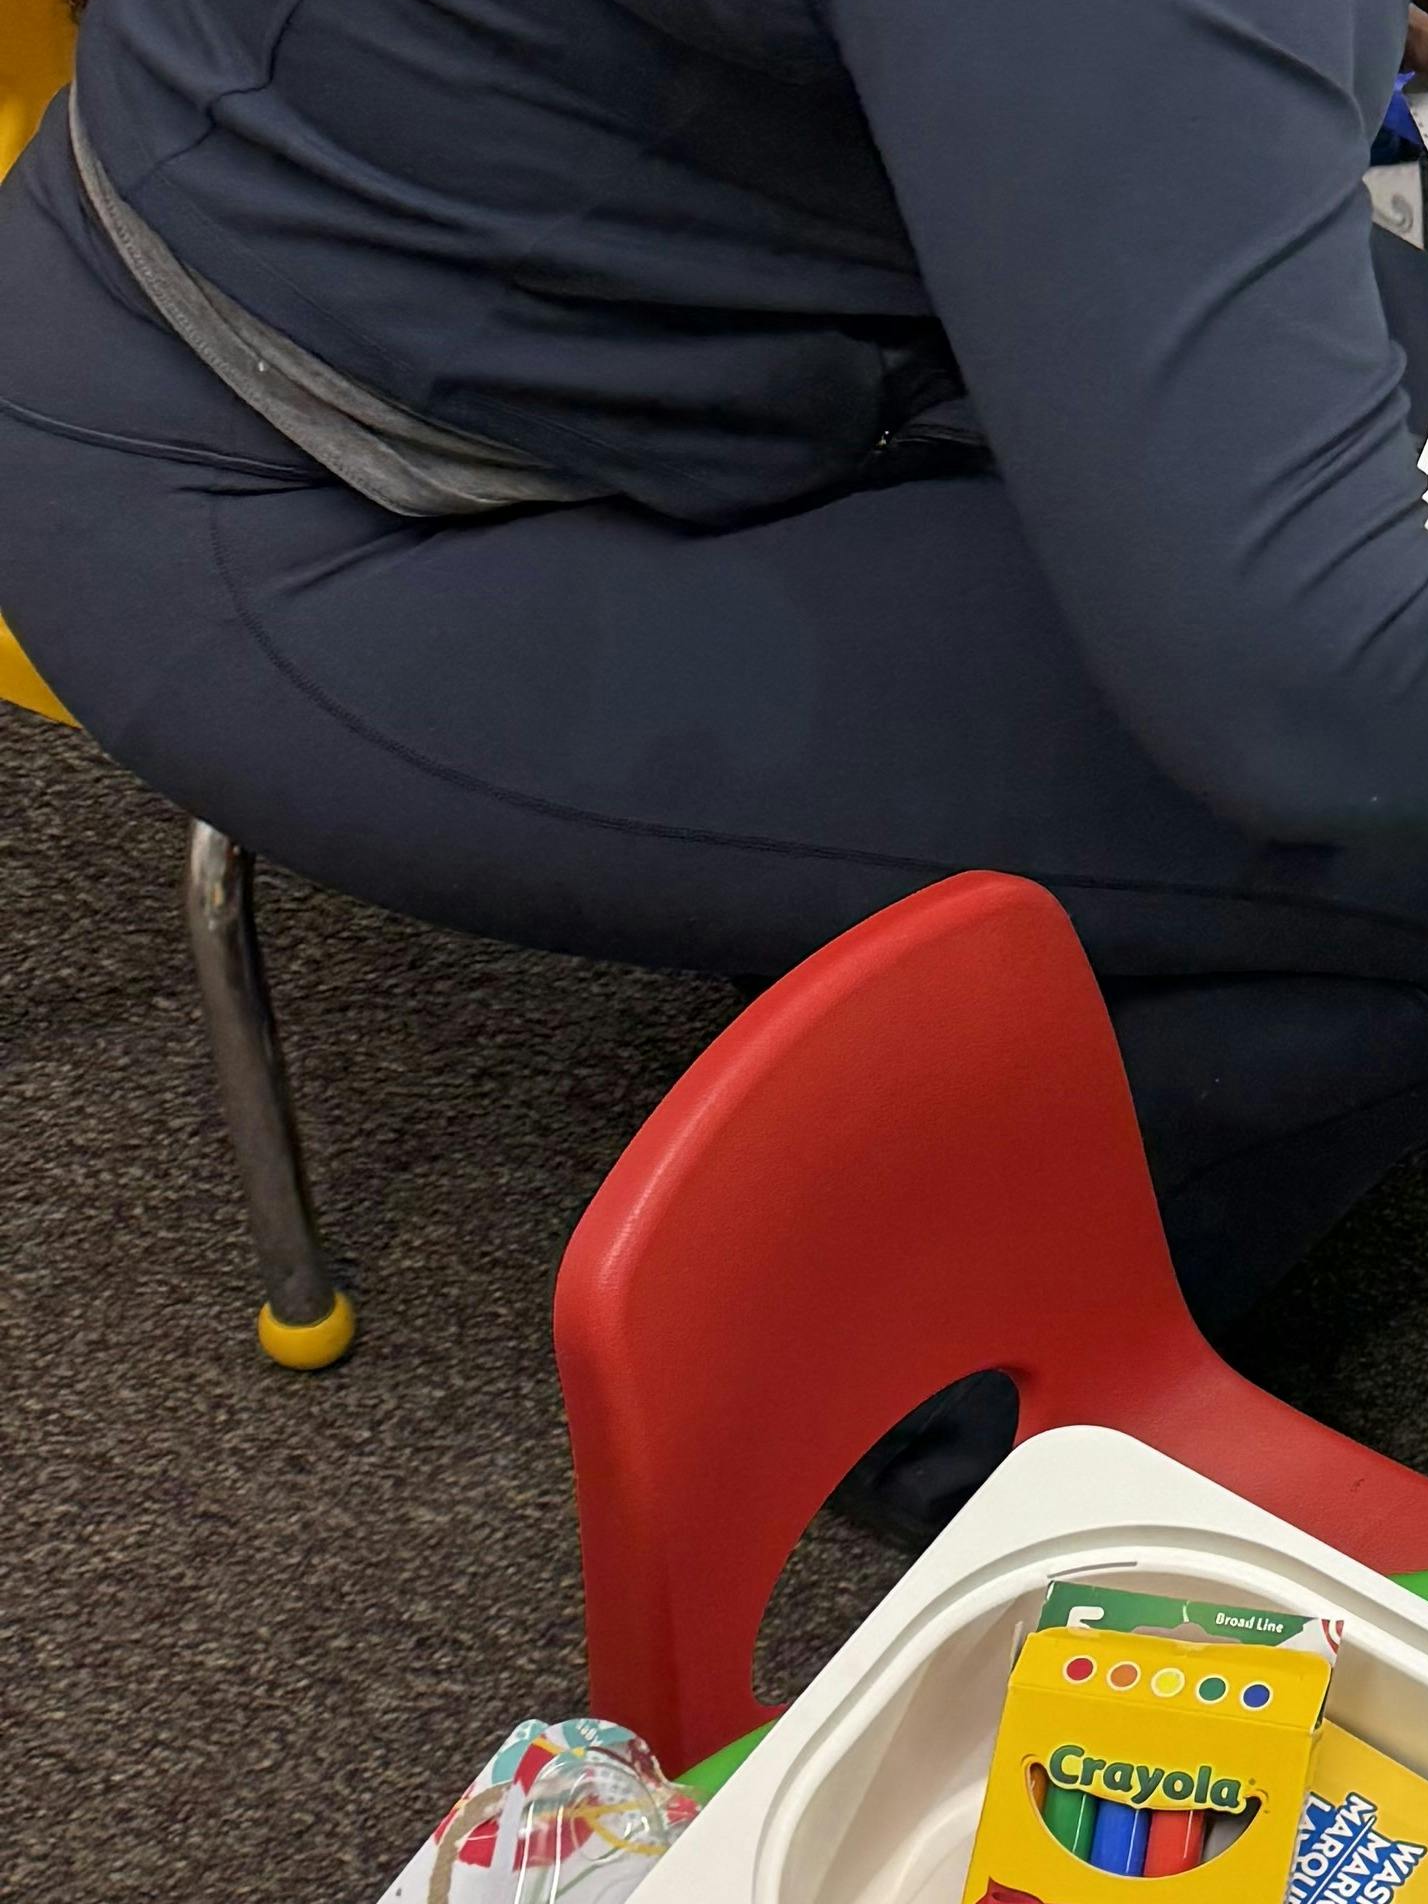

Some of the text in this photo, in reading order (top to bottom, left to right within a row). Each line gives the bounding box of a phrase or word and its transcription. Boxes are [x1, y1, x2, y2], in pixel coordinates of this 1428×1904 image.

[1215, 1611, 1285, 1635] Broad Line
[1049, 1744, 1242, 1808] Crayola
